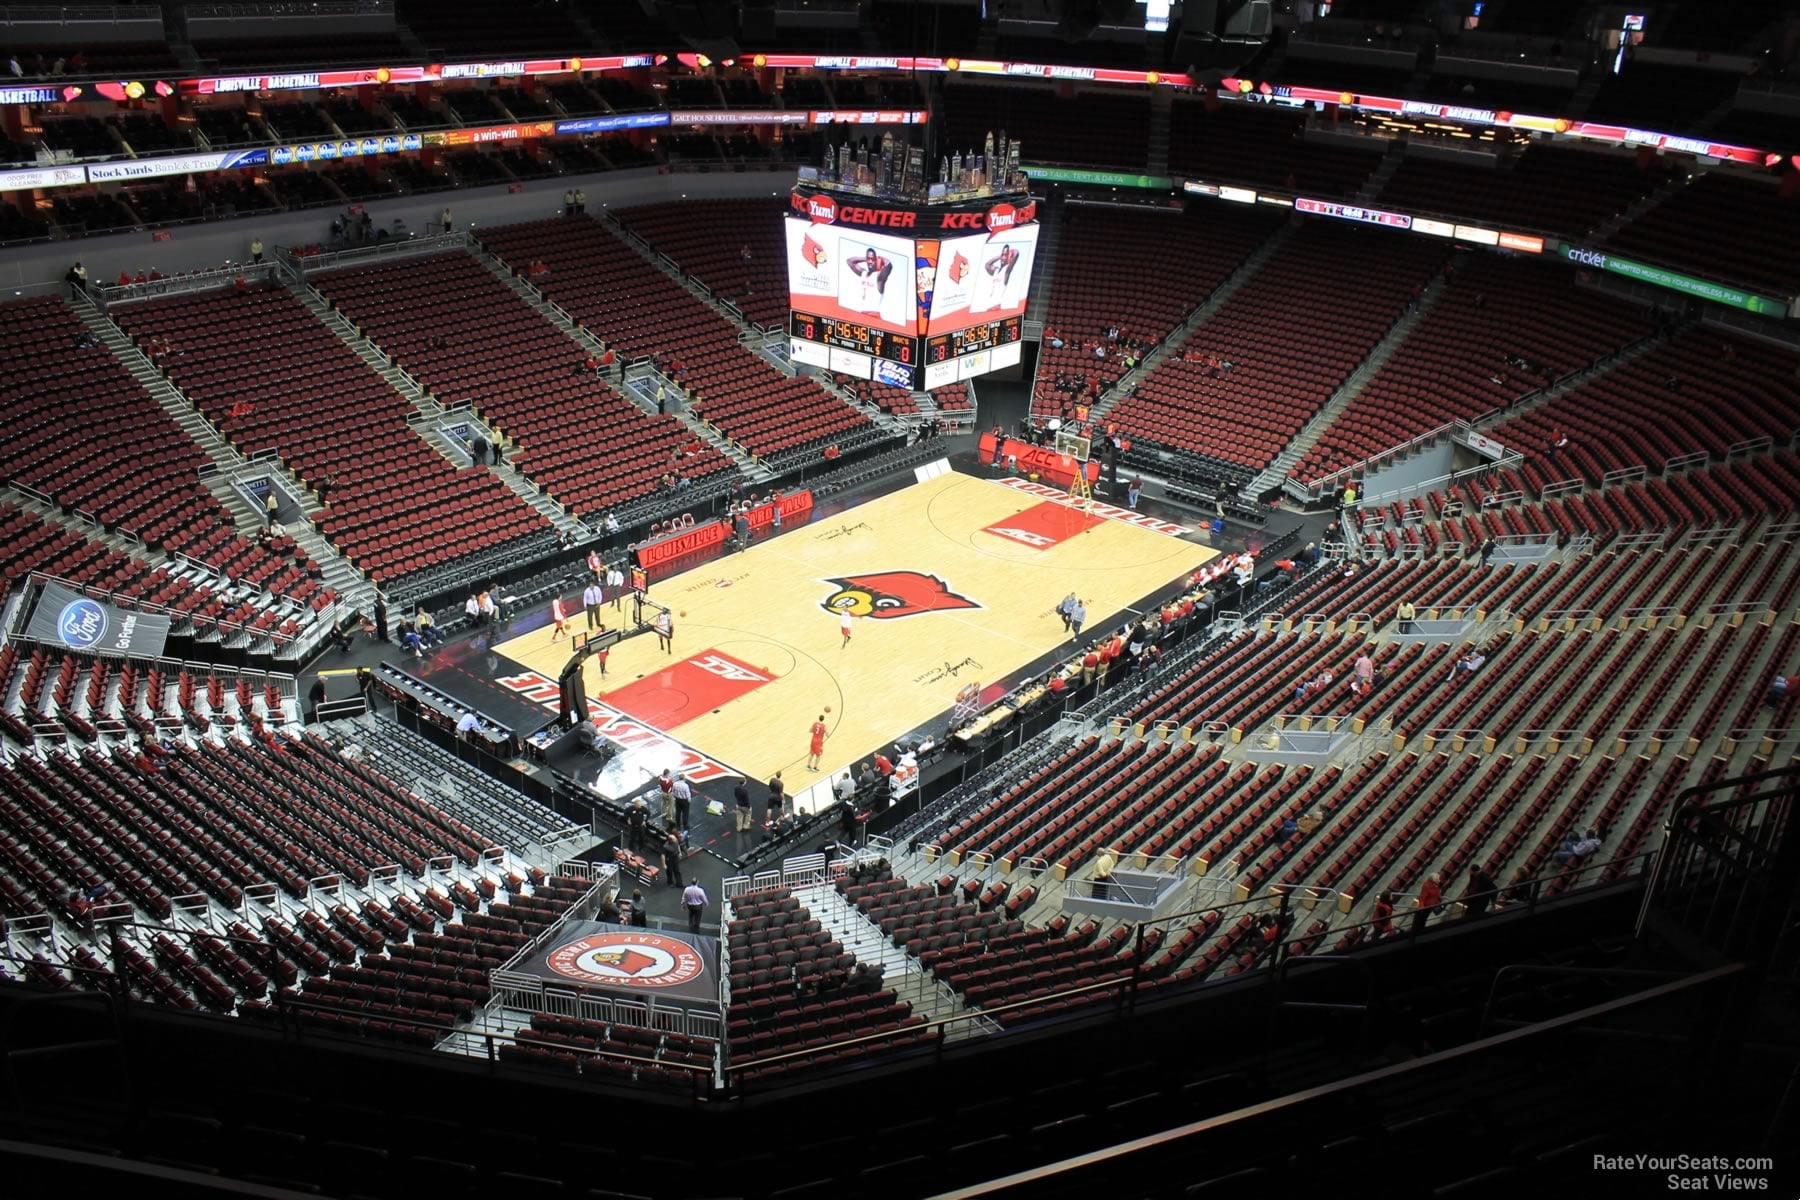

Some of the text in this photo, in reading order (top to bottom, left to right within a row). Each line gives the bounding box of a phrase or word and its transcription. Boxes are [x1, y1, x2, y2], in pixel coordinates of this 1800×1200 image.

[441, 62, 525, 78] LOUISVILLE BASKETBALL
[214, 74, 320, 92] LOUISVILLE BASKETBALL
[474, 132, 479, 142] a
[481, 127, 517, 141] win-win
[92, 168, 122, 179] Stock
[124, 165, 153, 176] Yards
[155, 161, 181, 173] Bank
[182, 160, 191, 169] &
[193, 159, 219, 169] Trust
[1102, 175, 1124, 183] DATA
[808, 200, 835, 219] Yum!
[840, 206, 917, 228] CENTER
[940, 212, 984, 229] KFC
[990, 209, 1016, 227] Yum!
[1568, 248, 1743, 303] cricket UNLIMITED MUSIC ON YOUR WIRELESS PLAN
[836, 322, 868, 342] 46:46
[1023, 449, 1058, 467] ACC
[646, 525, 718, 565] LOUISVILLE
[987, 527, 1057, 546] ACC
[64, 607, 101, 642] Ford
[115, 614, 138, 650] Go Further
[688, 655, 770, 682] ACC
[624, 936, 661, 945] CAP
[638, 953, 697, 985] CARDINAL
